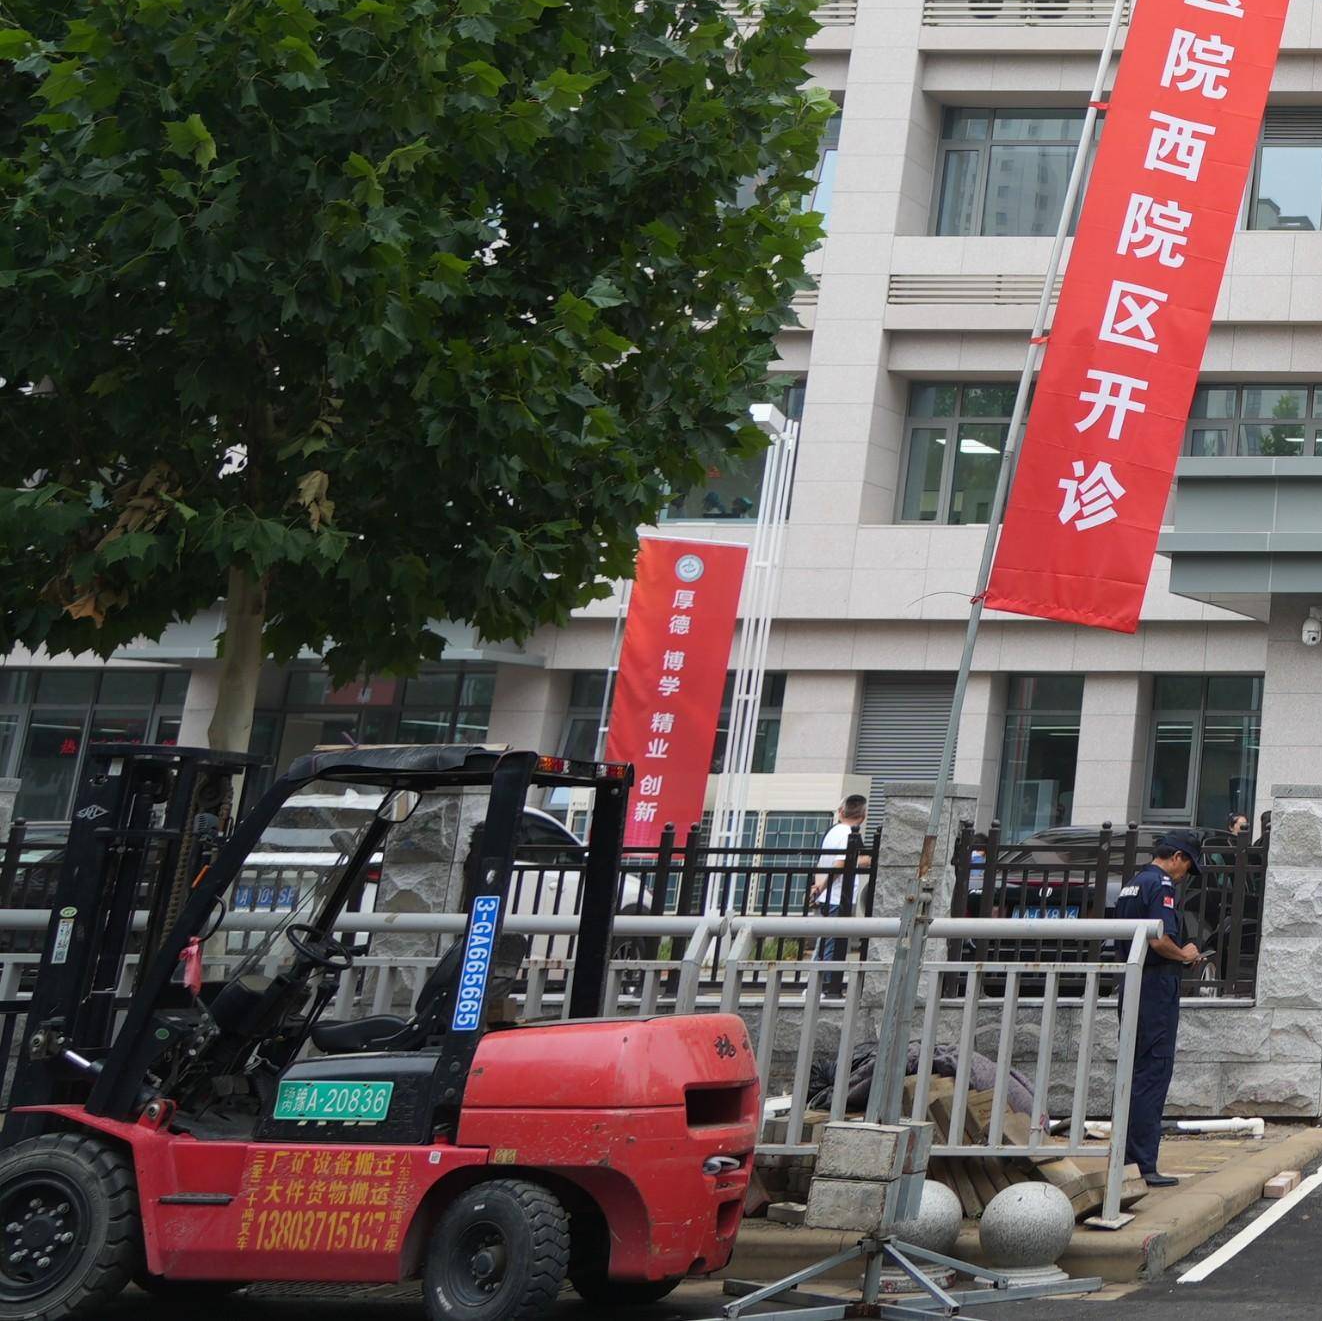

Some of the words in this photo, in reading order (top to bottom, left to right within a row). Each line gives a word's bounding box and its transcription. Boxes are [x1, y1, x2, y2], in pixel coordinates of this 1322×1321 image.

[668, 589, 696, 635] 厚德
[657, 649, 685, 697] 博学
[645, 712, 675, 759] 精业
[634, 774, 664, 822] 创新
[456, 899, 497, 1026] 3-GA665665
[263, 1179, 392, 1206] 大件货物搬运
